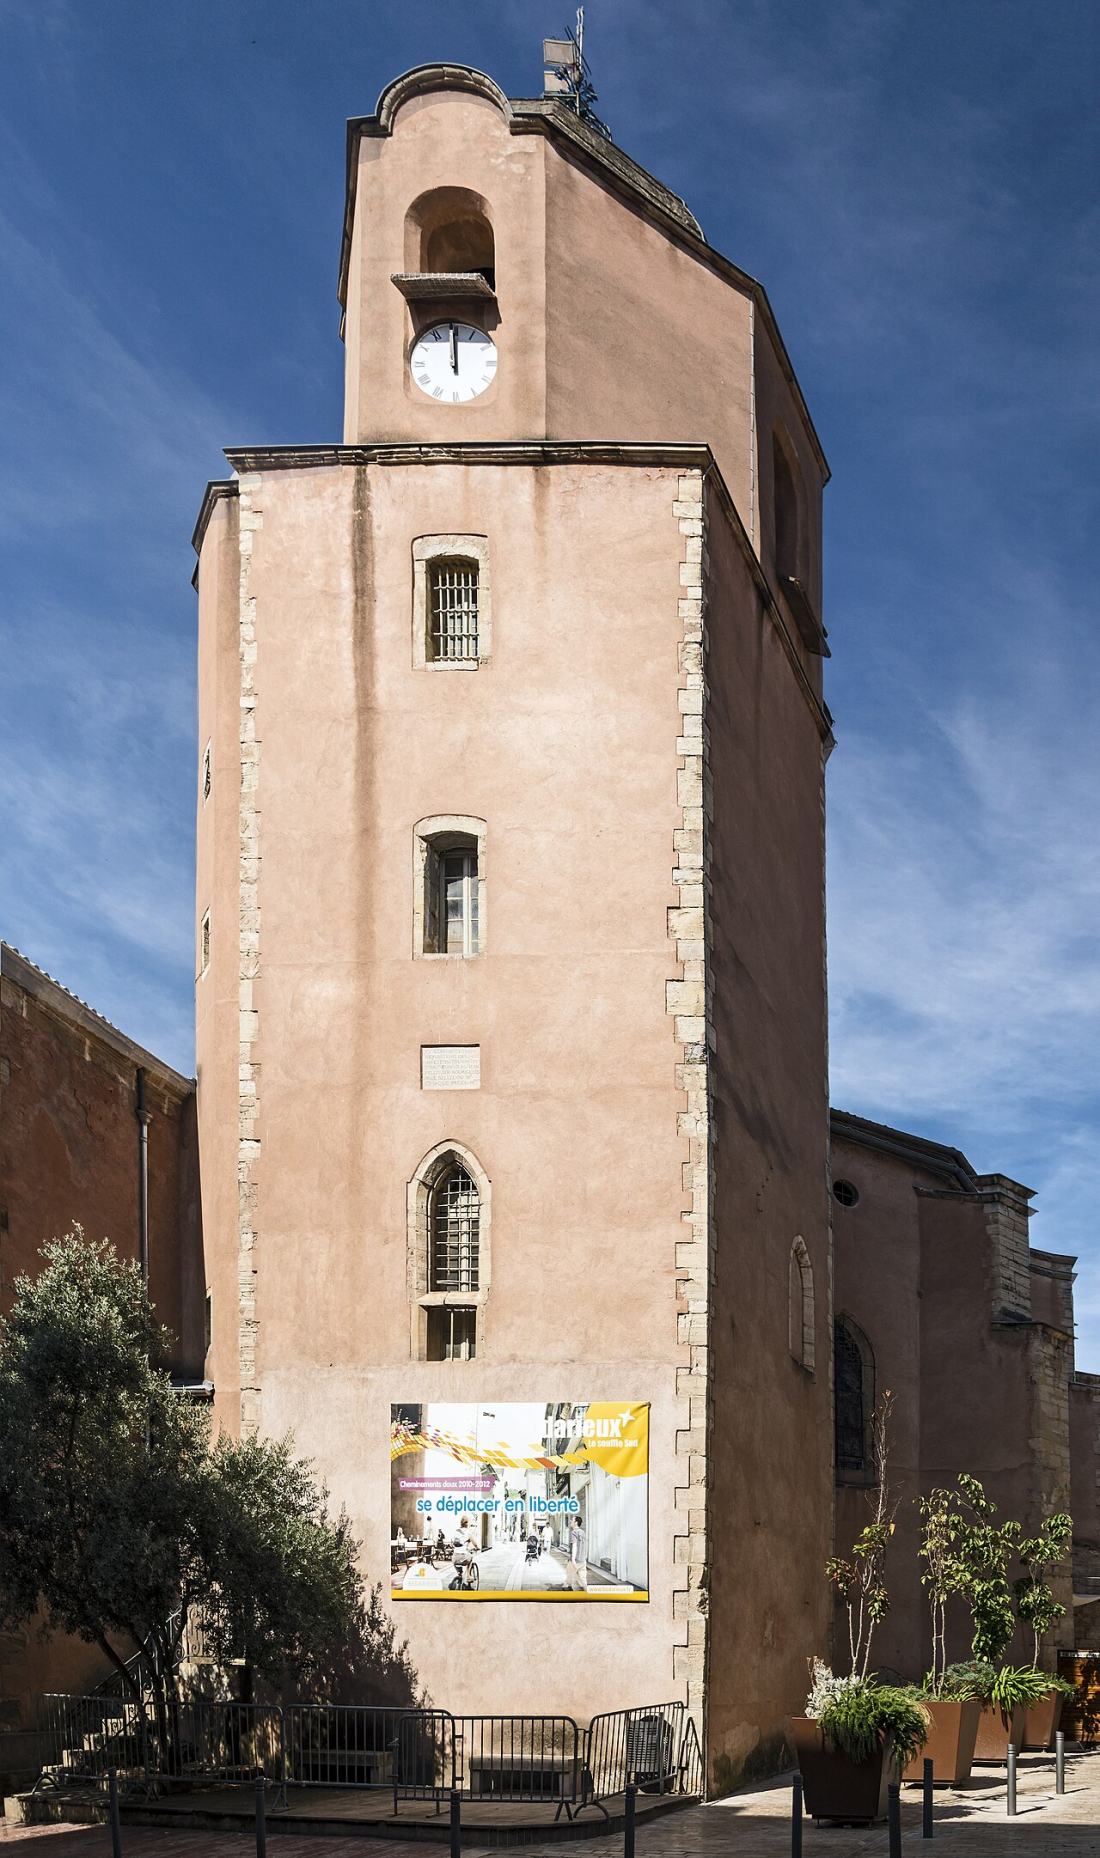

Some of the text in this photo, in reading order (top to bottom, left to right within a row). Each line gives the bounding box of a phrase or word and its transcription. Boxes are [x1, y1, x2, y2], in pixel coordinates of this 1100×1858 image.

[400, 1480, 490, 1488] Cheminements doux 2010-2012
[417, 1495, 579, 1515] se déplacer en liberté
